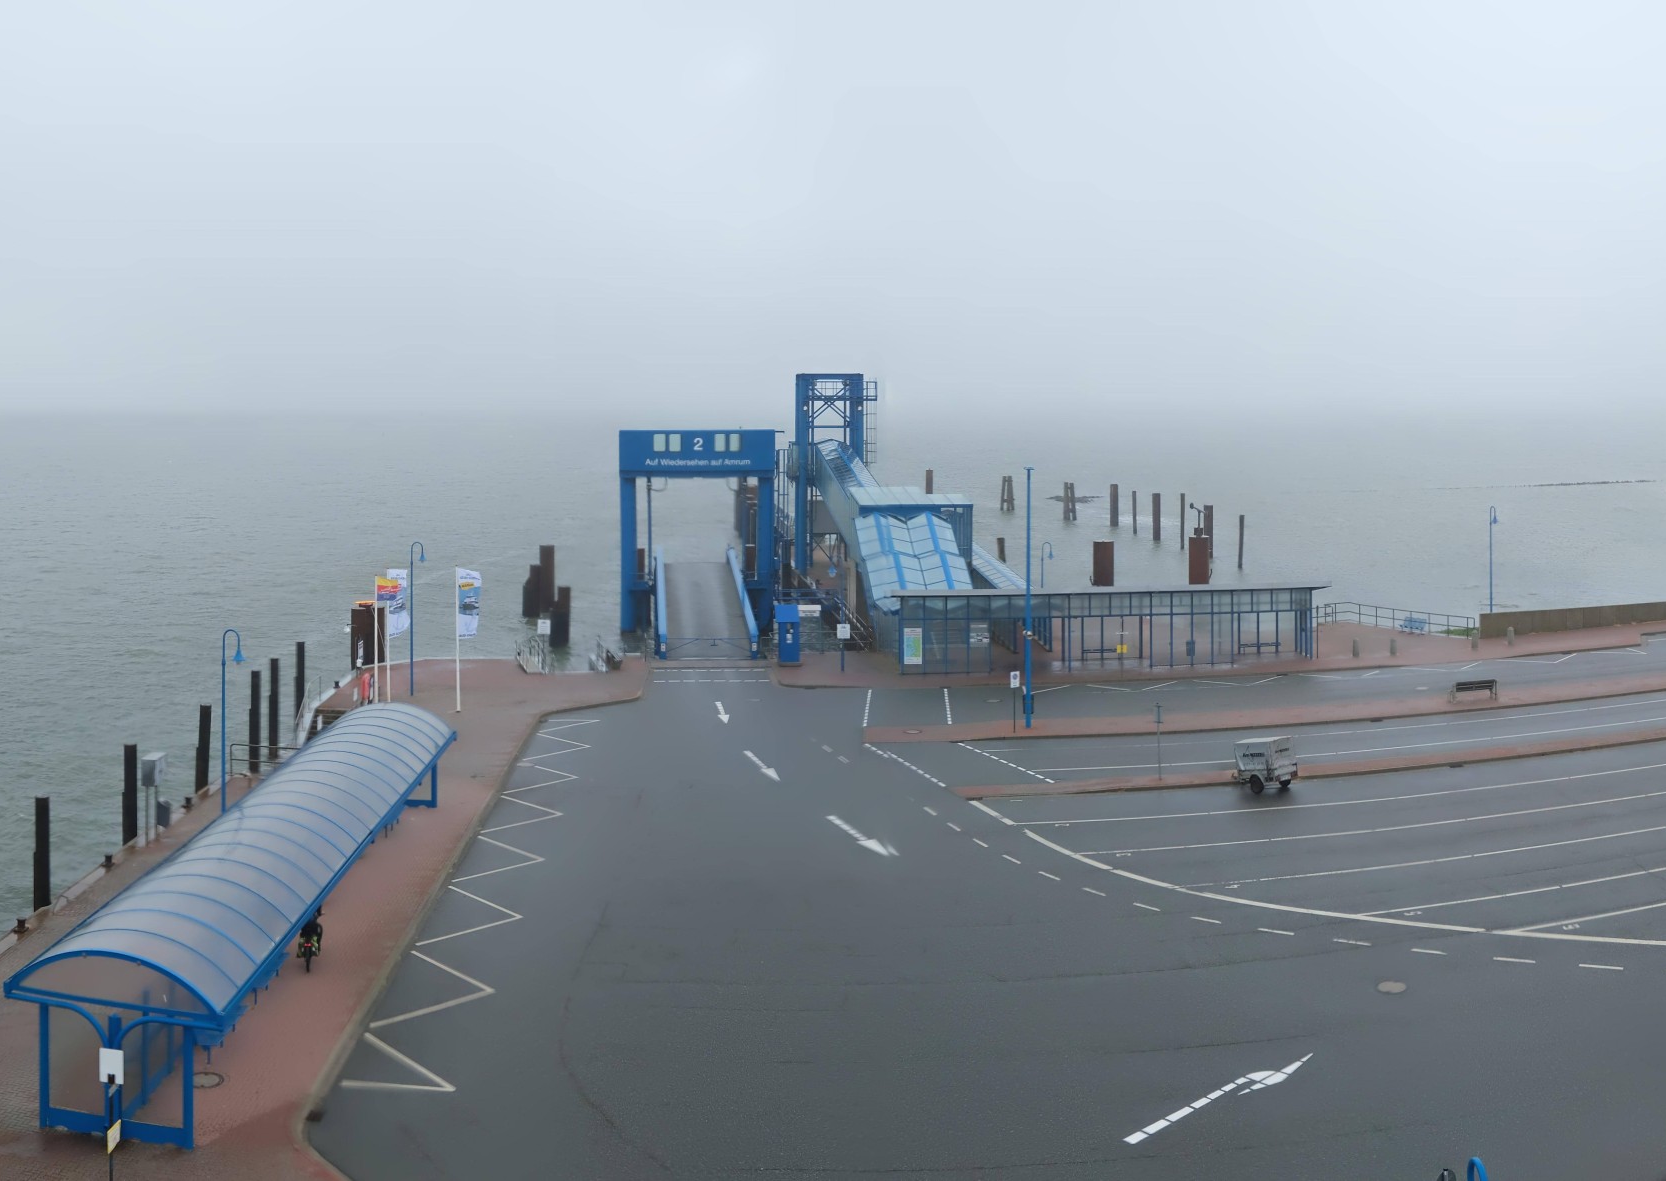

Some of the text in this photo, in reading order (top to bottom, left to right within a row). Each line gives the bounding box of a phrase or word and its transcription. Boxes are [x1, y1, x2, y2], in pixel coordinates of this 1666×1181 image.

[693, 437, 704, 451] 2
[645, 458, 751, 466] Auf Wiedersehen auf Amrum
